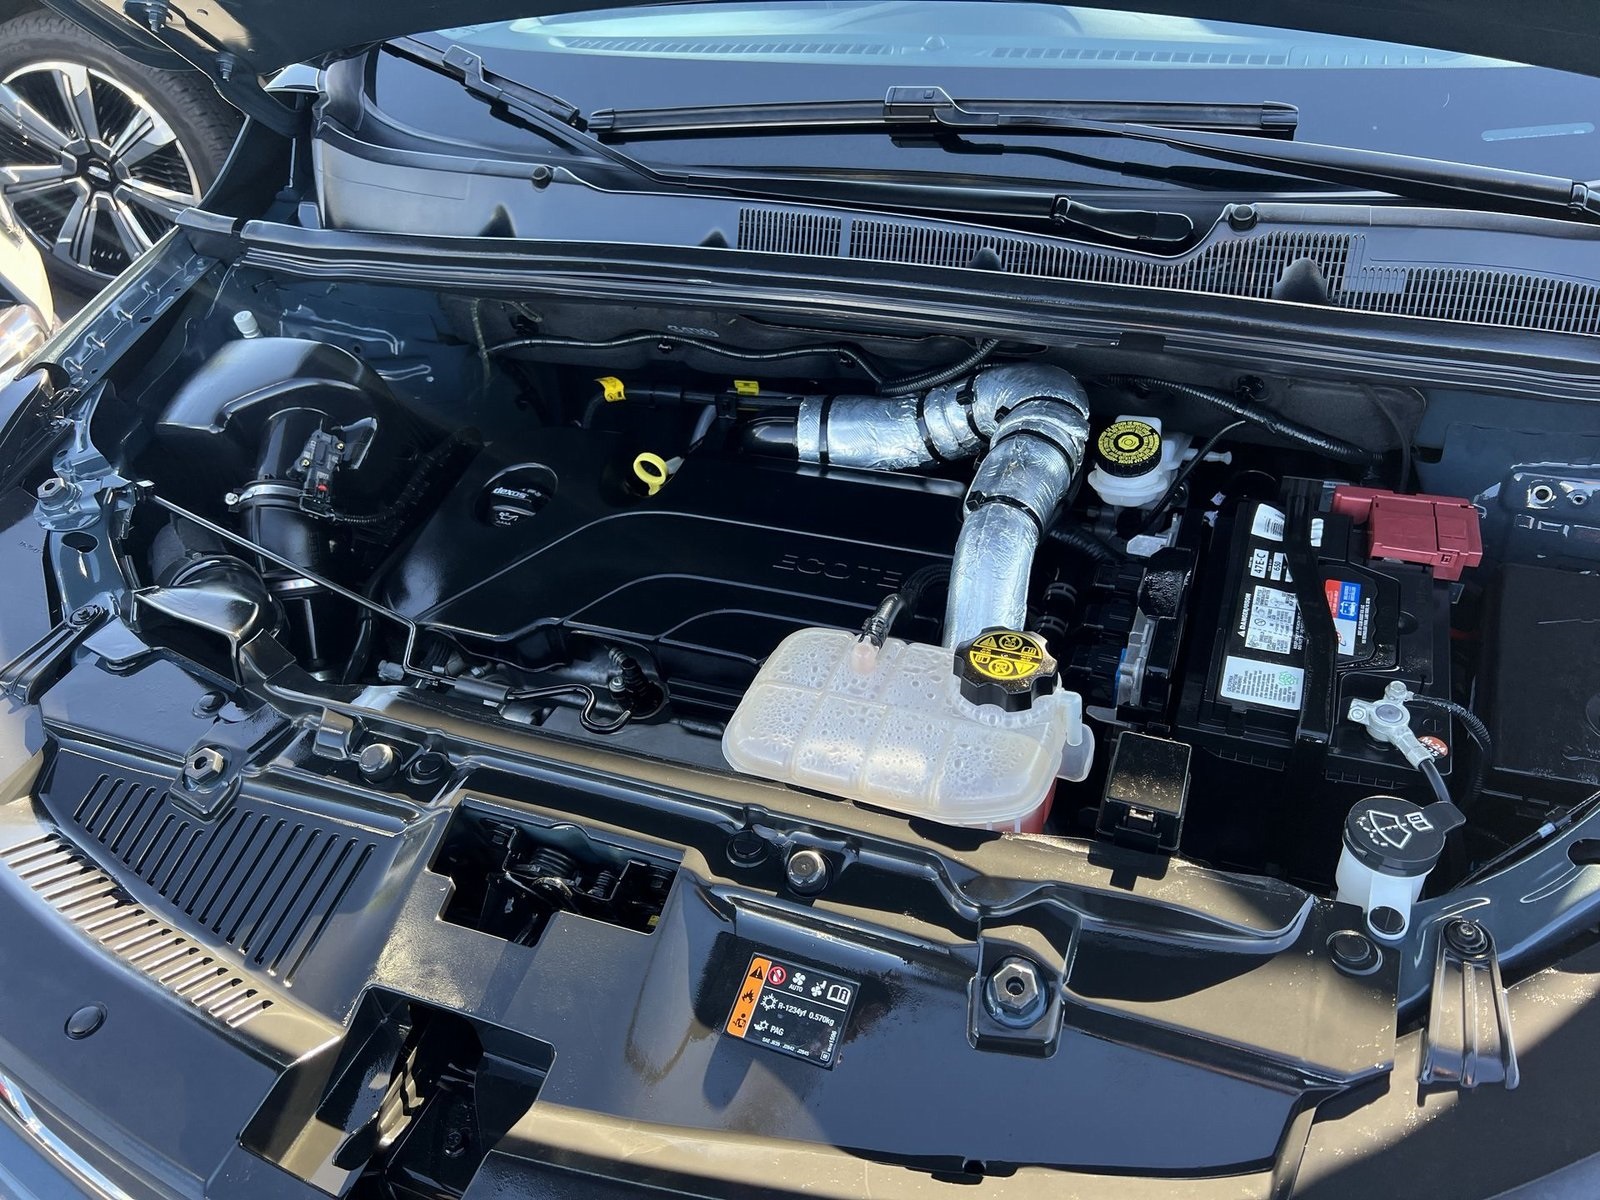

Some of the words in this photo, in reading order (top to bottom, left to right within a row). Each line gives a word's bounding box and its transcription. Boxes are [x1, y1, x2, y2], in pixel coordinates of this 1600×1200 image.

[492, 487, 527, 498] dexos
[1254, 553, 1266, 574] 47E-C
[772, 554, 903, 589] ECOTE
[788, 984, 803, 993] AUTO
[808, 1011, 835, 1026] 0.570kg
[769, 1025, 785, 1036] PAG
